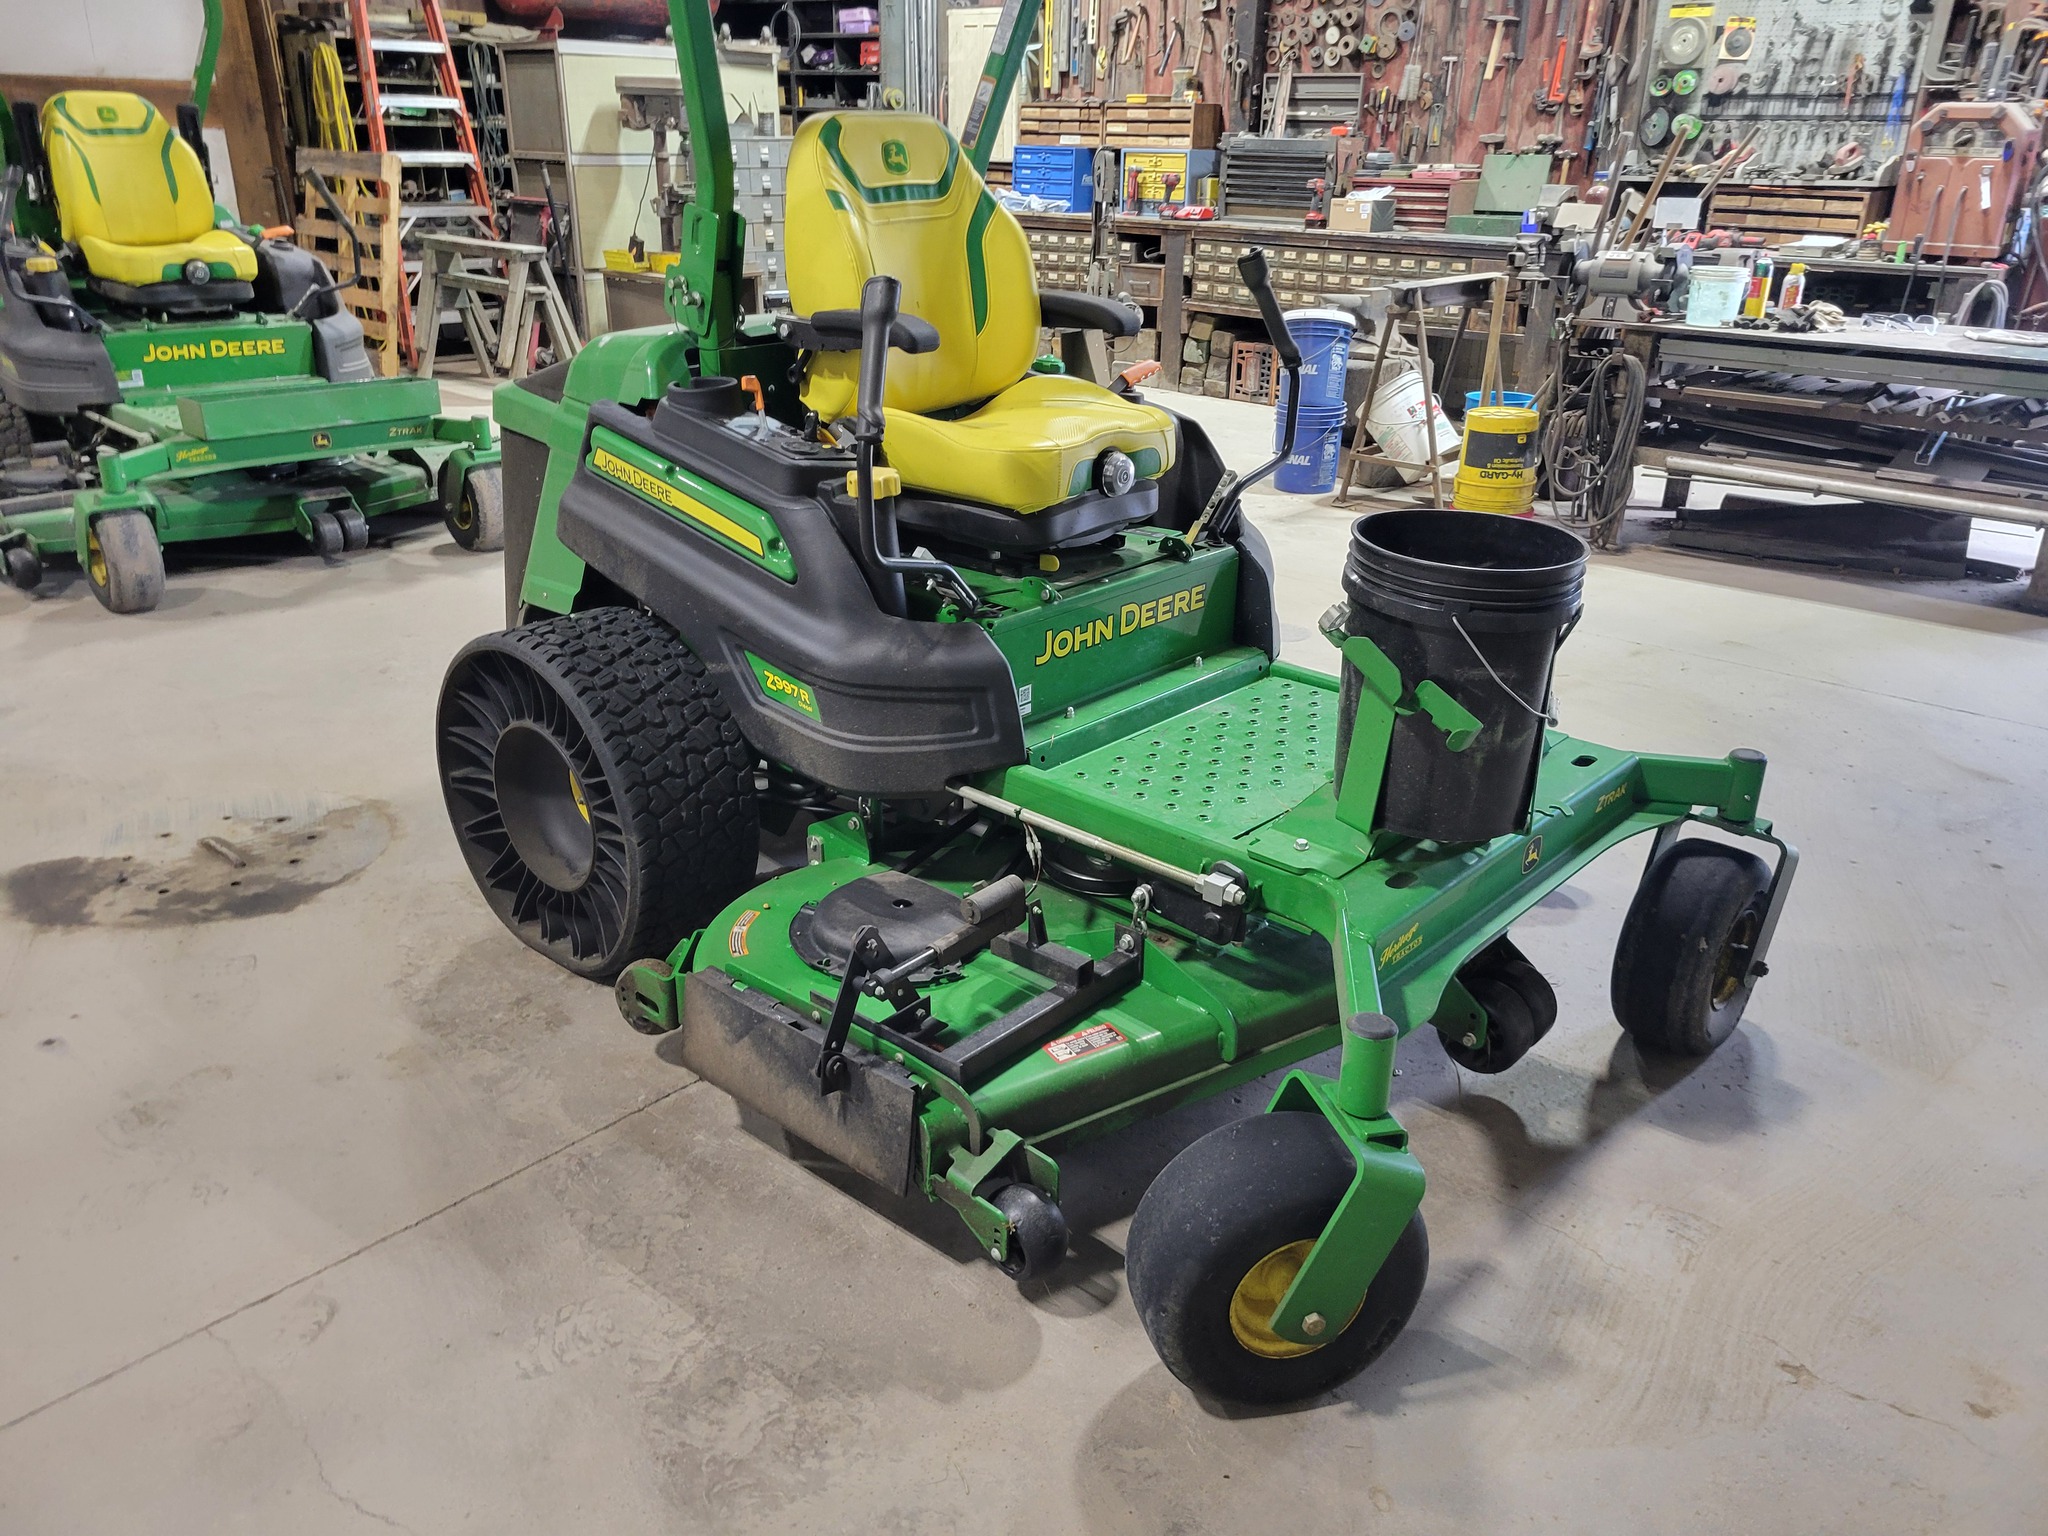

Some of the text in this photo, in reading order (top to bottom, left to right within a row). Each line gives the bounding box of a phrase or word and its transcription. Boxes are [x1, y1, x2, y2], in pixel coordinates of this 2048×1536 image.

[143, 338, 286, 363] JOHN DEERE
[601, 453, 673, 504] JOHN DEERE
[1035, 583, 1206, 666] JOHN DEERE
[1595, 782, 1628, 813] ZTRAK
